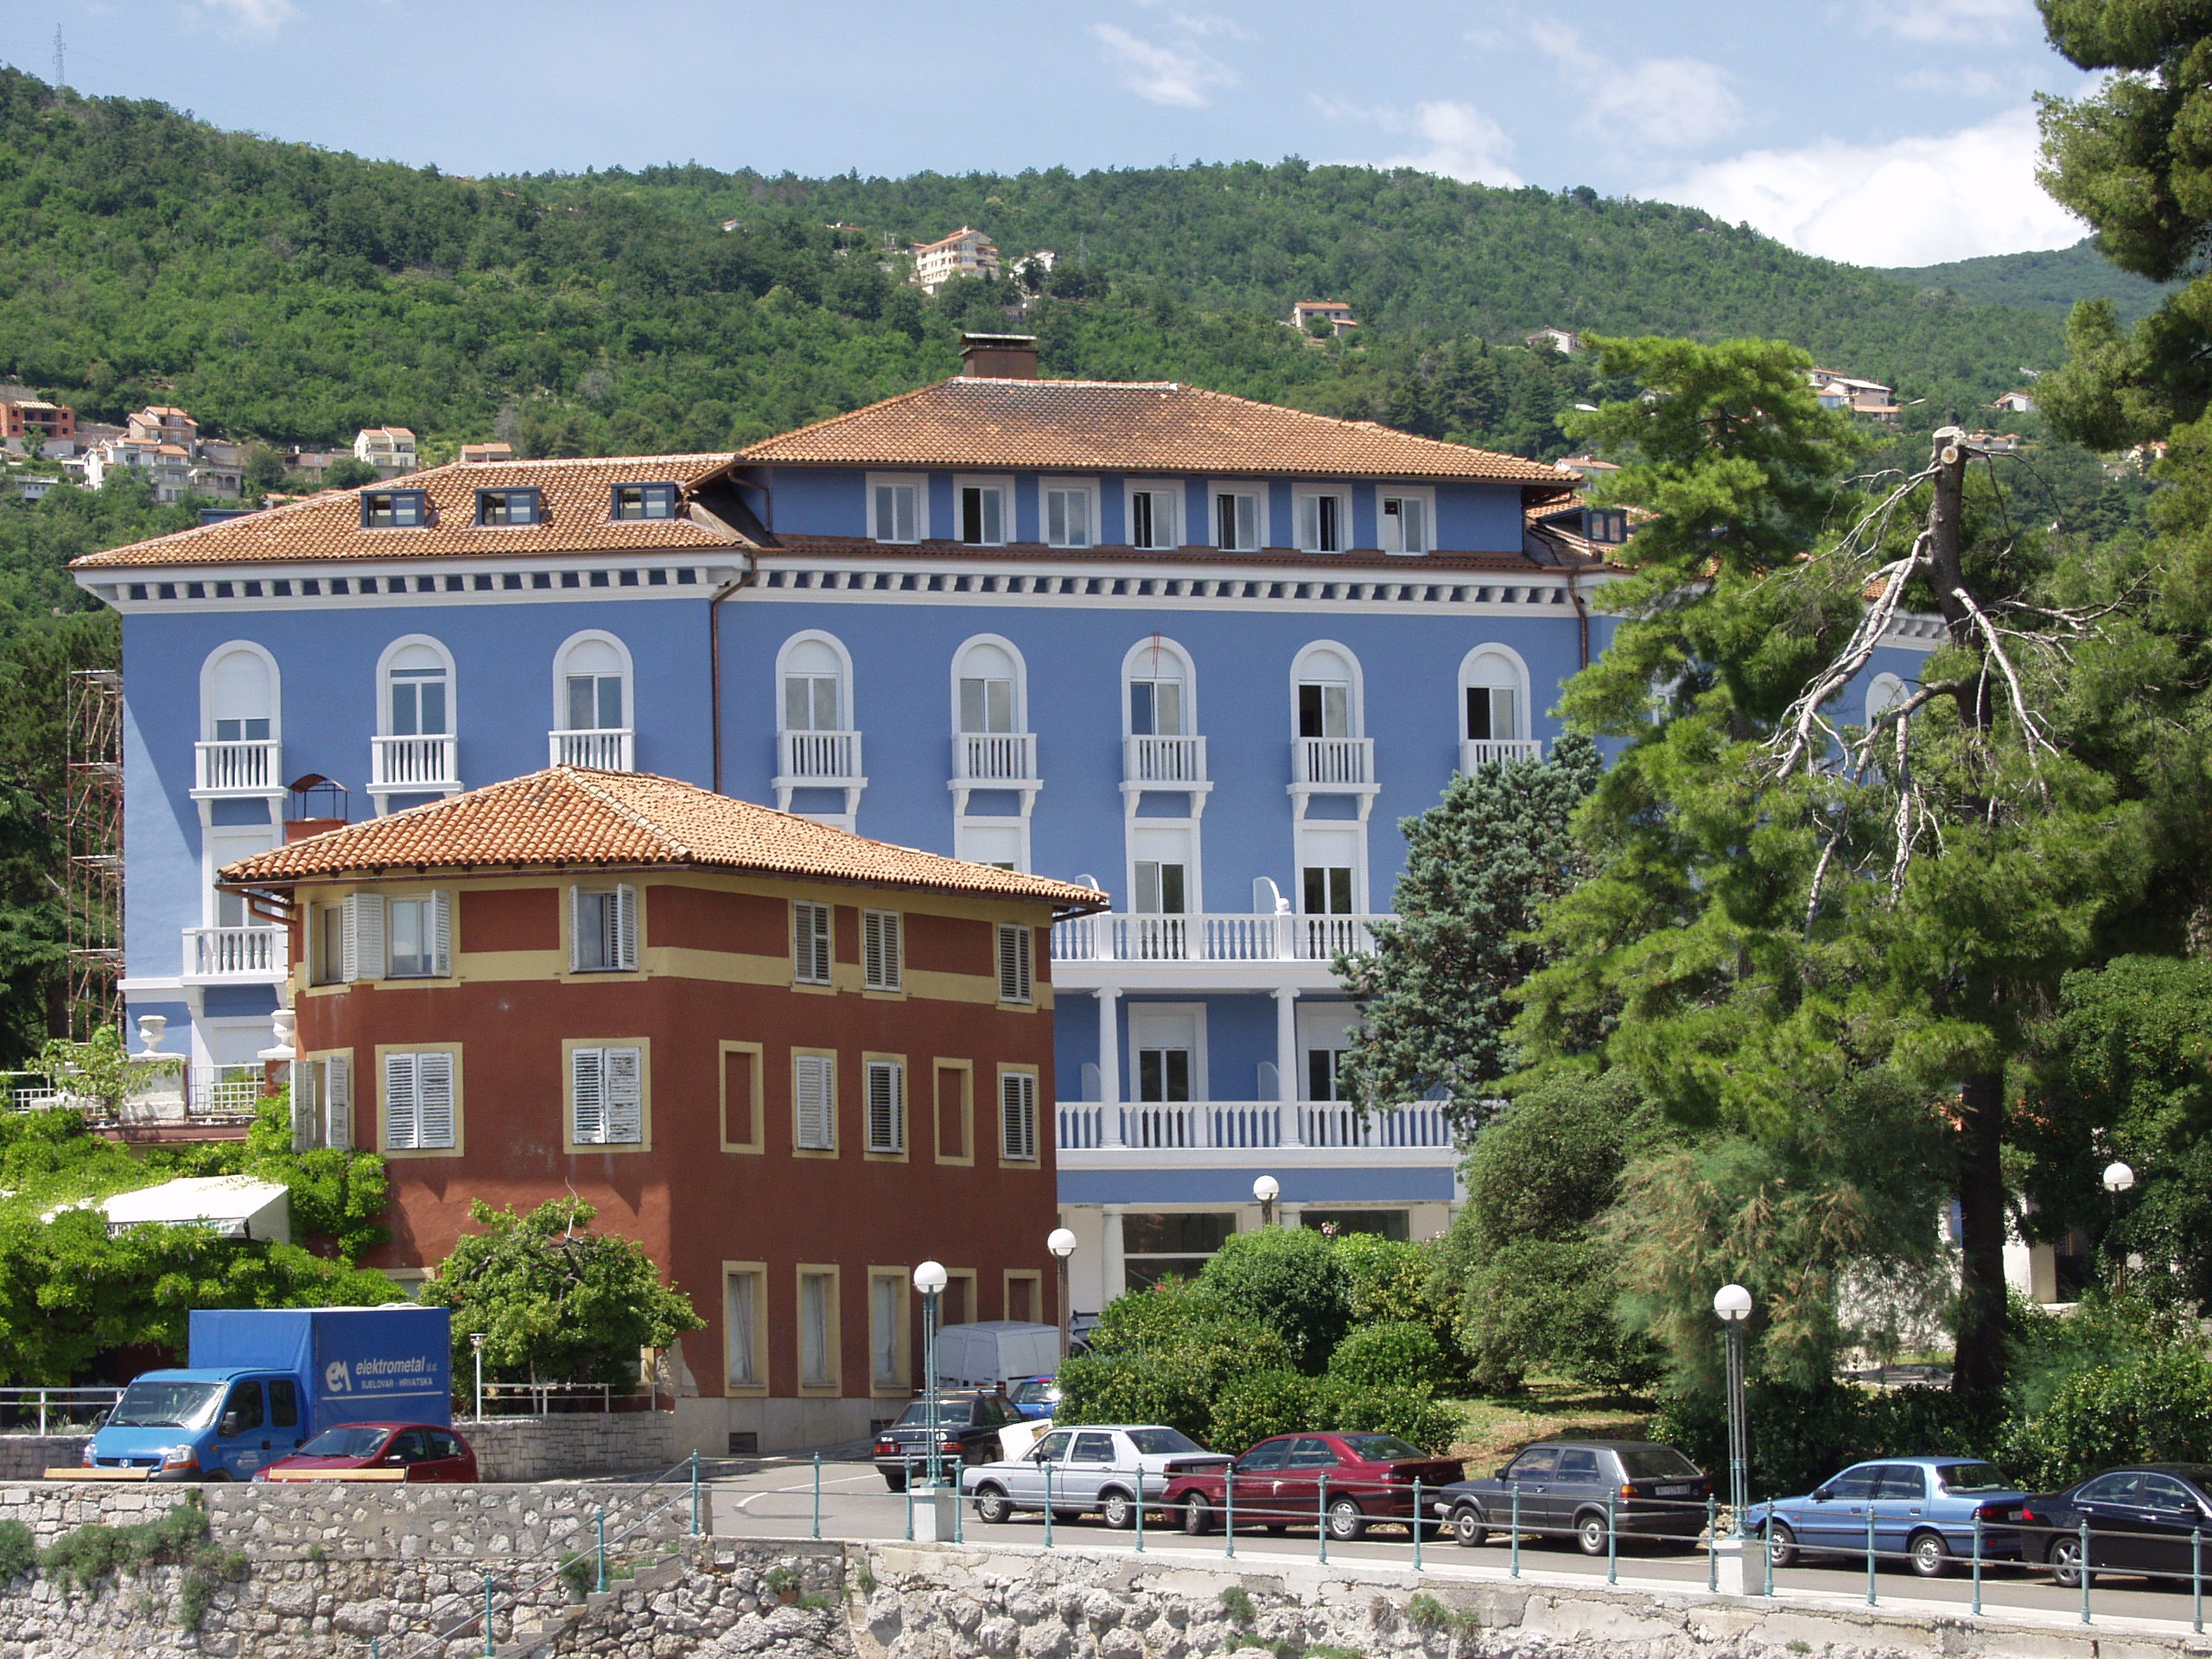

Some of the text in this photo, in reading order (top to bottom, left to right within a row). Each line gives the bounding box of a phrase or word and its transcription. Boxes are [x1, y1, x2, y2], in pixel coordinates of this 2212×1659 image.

[356, 1356, 426, 1376] elektrometal
[361, 1378, 394, 1389] BJELOVAR
[399, 1377, 433, 1387] HRVATSKA
